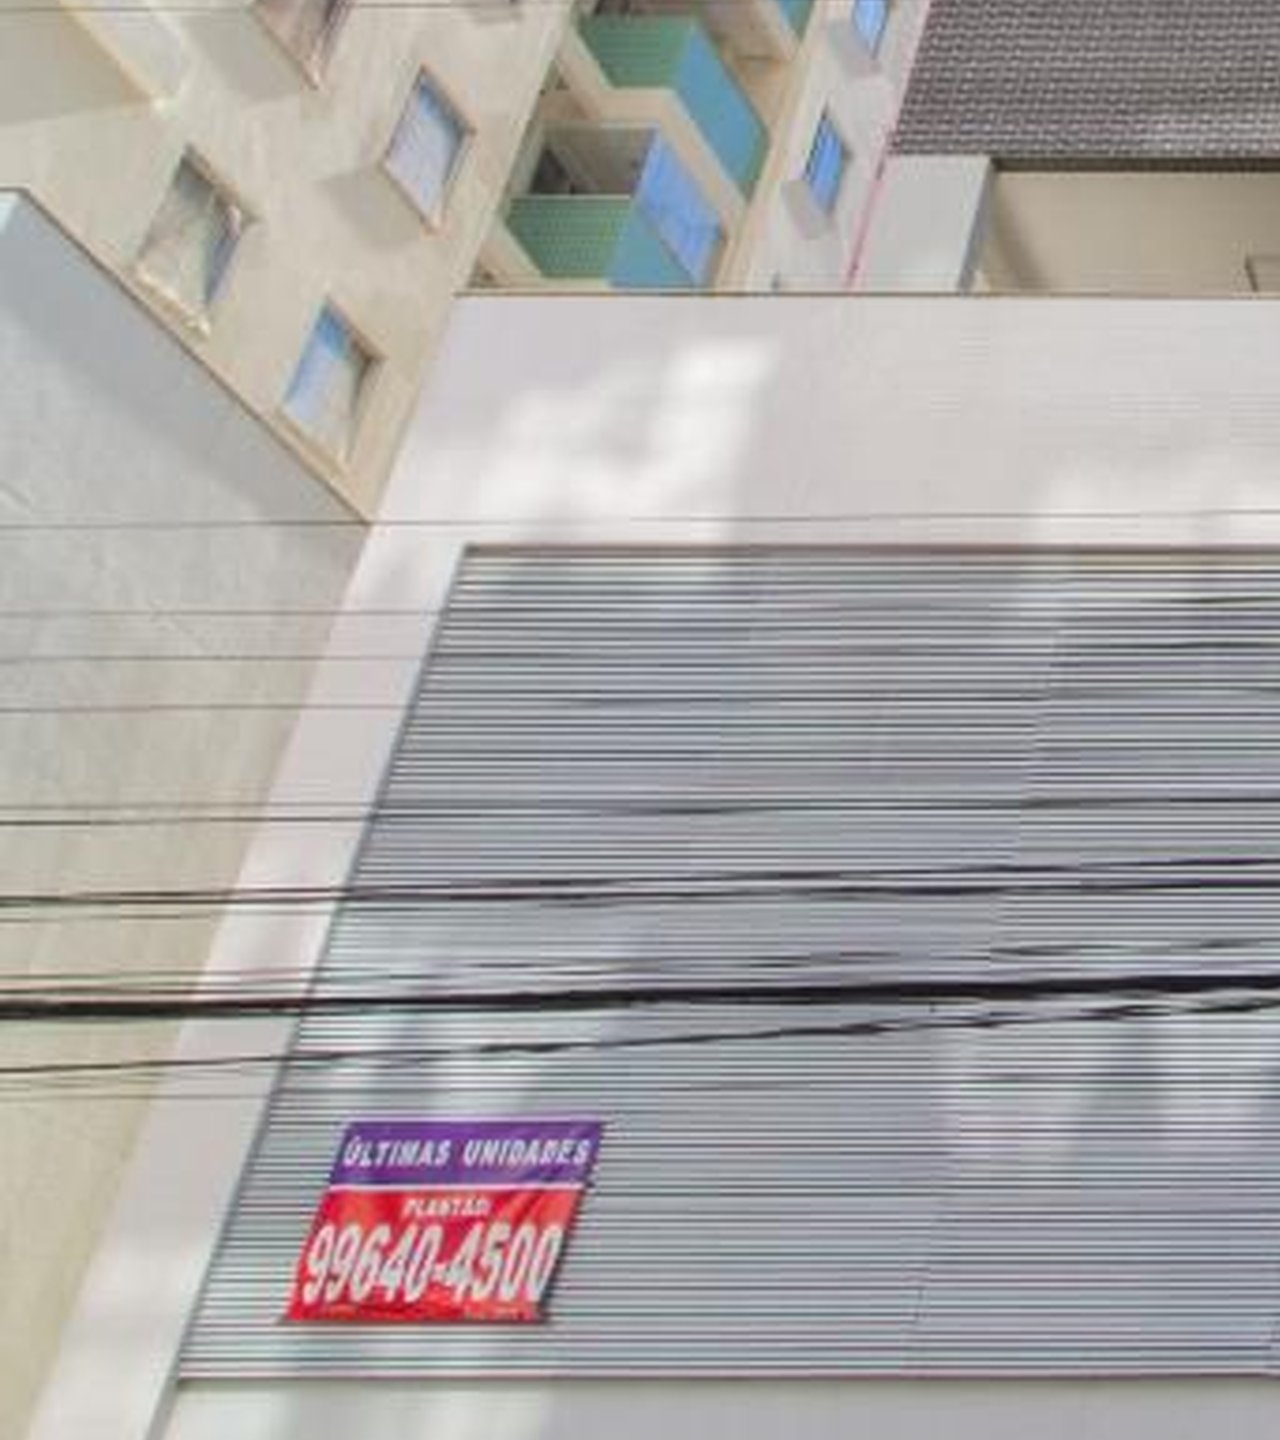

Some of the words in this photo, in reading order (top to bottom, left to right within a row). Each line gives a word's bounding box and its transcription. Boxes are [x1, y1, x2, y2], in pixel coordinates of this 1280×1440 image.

[343, 1137, 451, 1167] ÚLTIMAS
[464, 1138, 592, 1166] UNIDADES
[303, 1223, 563, 1304] 99640-4500
